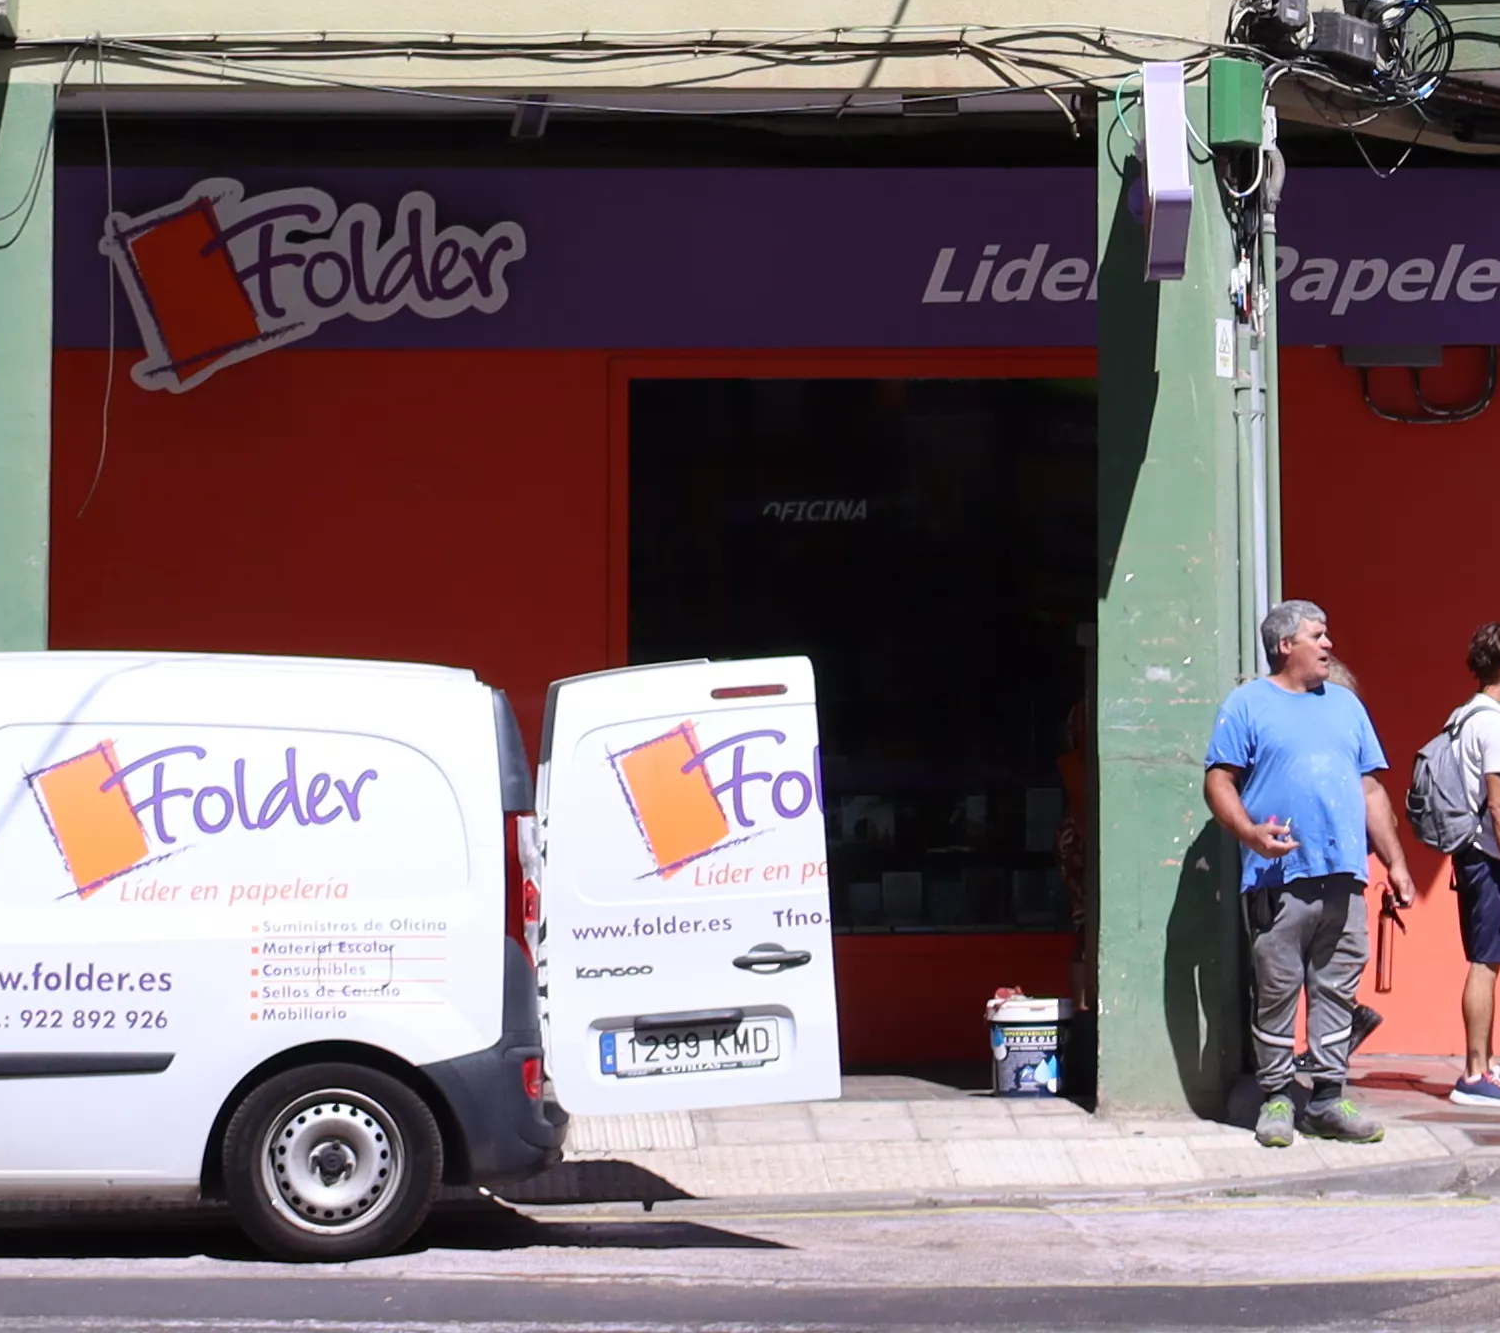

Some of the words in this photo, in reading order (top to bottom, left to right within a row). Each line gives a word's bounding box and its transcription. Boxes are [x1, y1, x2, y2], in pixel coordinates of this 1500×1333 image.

[200, 204, 514, 317] Folder
[100, 744, 378, 844] Folder
[694, 860, 754, 887] Líder
[763, 863, 790, 882] en
[120, 879, 182, 903] Líder
[190, 883, 218, 901] en
[229, 877, 350, 906] papelería
[262, 920, 358, 933] Suministros
[364, 919, 384, 932] de
[389, 917, 448, 933] Oficina
[572, 916, 733, 941] www.folder.es
[773, 909, 831, 928] Tfno.
[262, 940, 330, 955] Material
[338, 941, 394, 953] Escolar
[262, 962, 366, 978] Consumibles
[262, 984, 311, 999] Sellos
[317, 985, 336, 999] de
[20, 1011, 63, 1029] 922
[72, 1011, 116, 1029] 892
[126, 1010, 168, 1029] 926
[262, 1006, 347, 1021] Mobiliario
[628, 1032, 700, 1064] 1299
[713, 1027, 770, 1057] KMD
